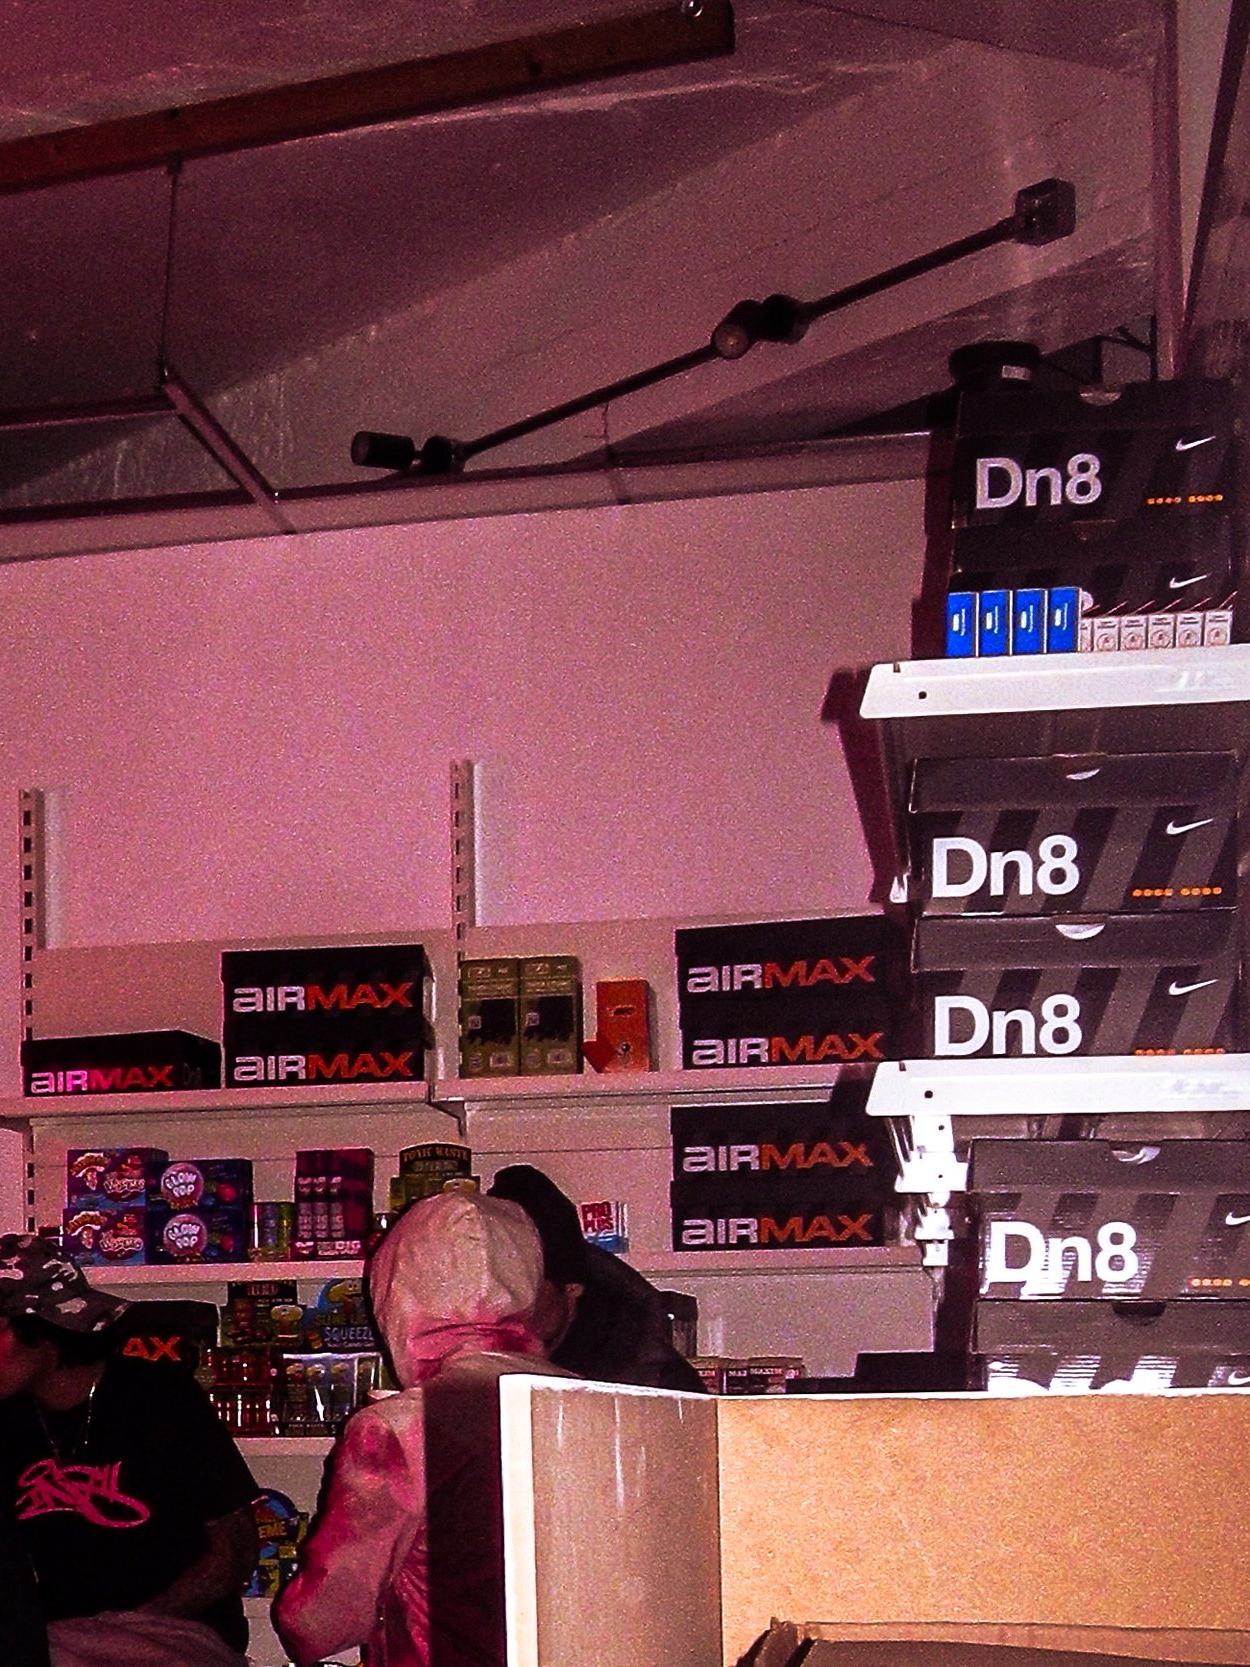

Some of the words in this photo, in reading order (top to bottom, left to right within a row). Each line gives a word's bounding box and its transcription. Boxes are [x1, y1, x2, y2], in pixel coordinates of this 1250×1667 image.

[975, 452, 1102, 509] Dn8
[932, 834, 1080, 898] Dn8
[934, 994, 1082, 1057] Dn8
[581, 1202, 611, 1219] PRO
[989, 1221, 1139, 1283] Dn8
